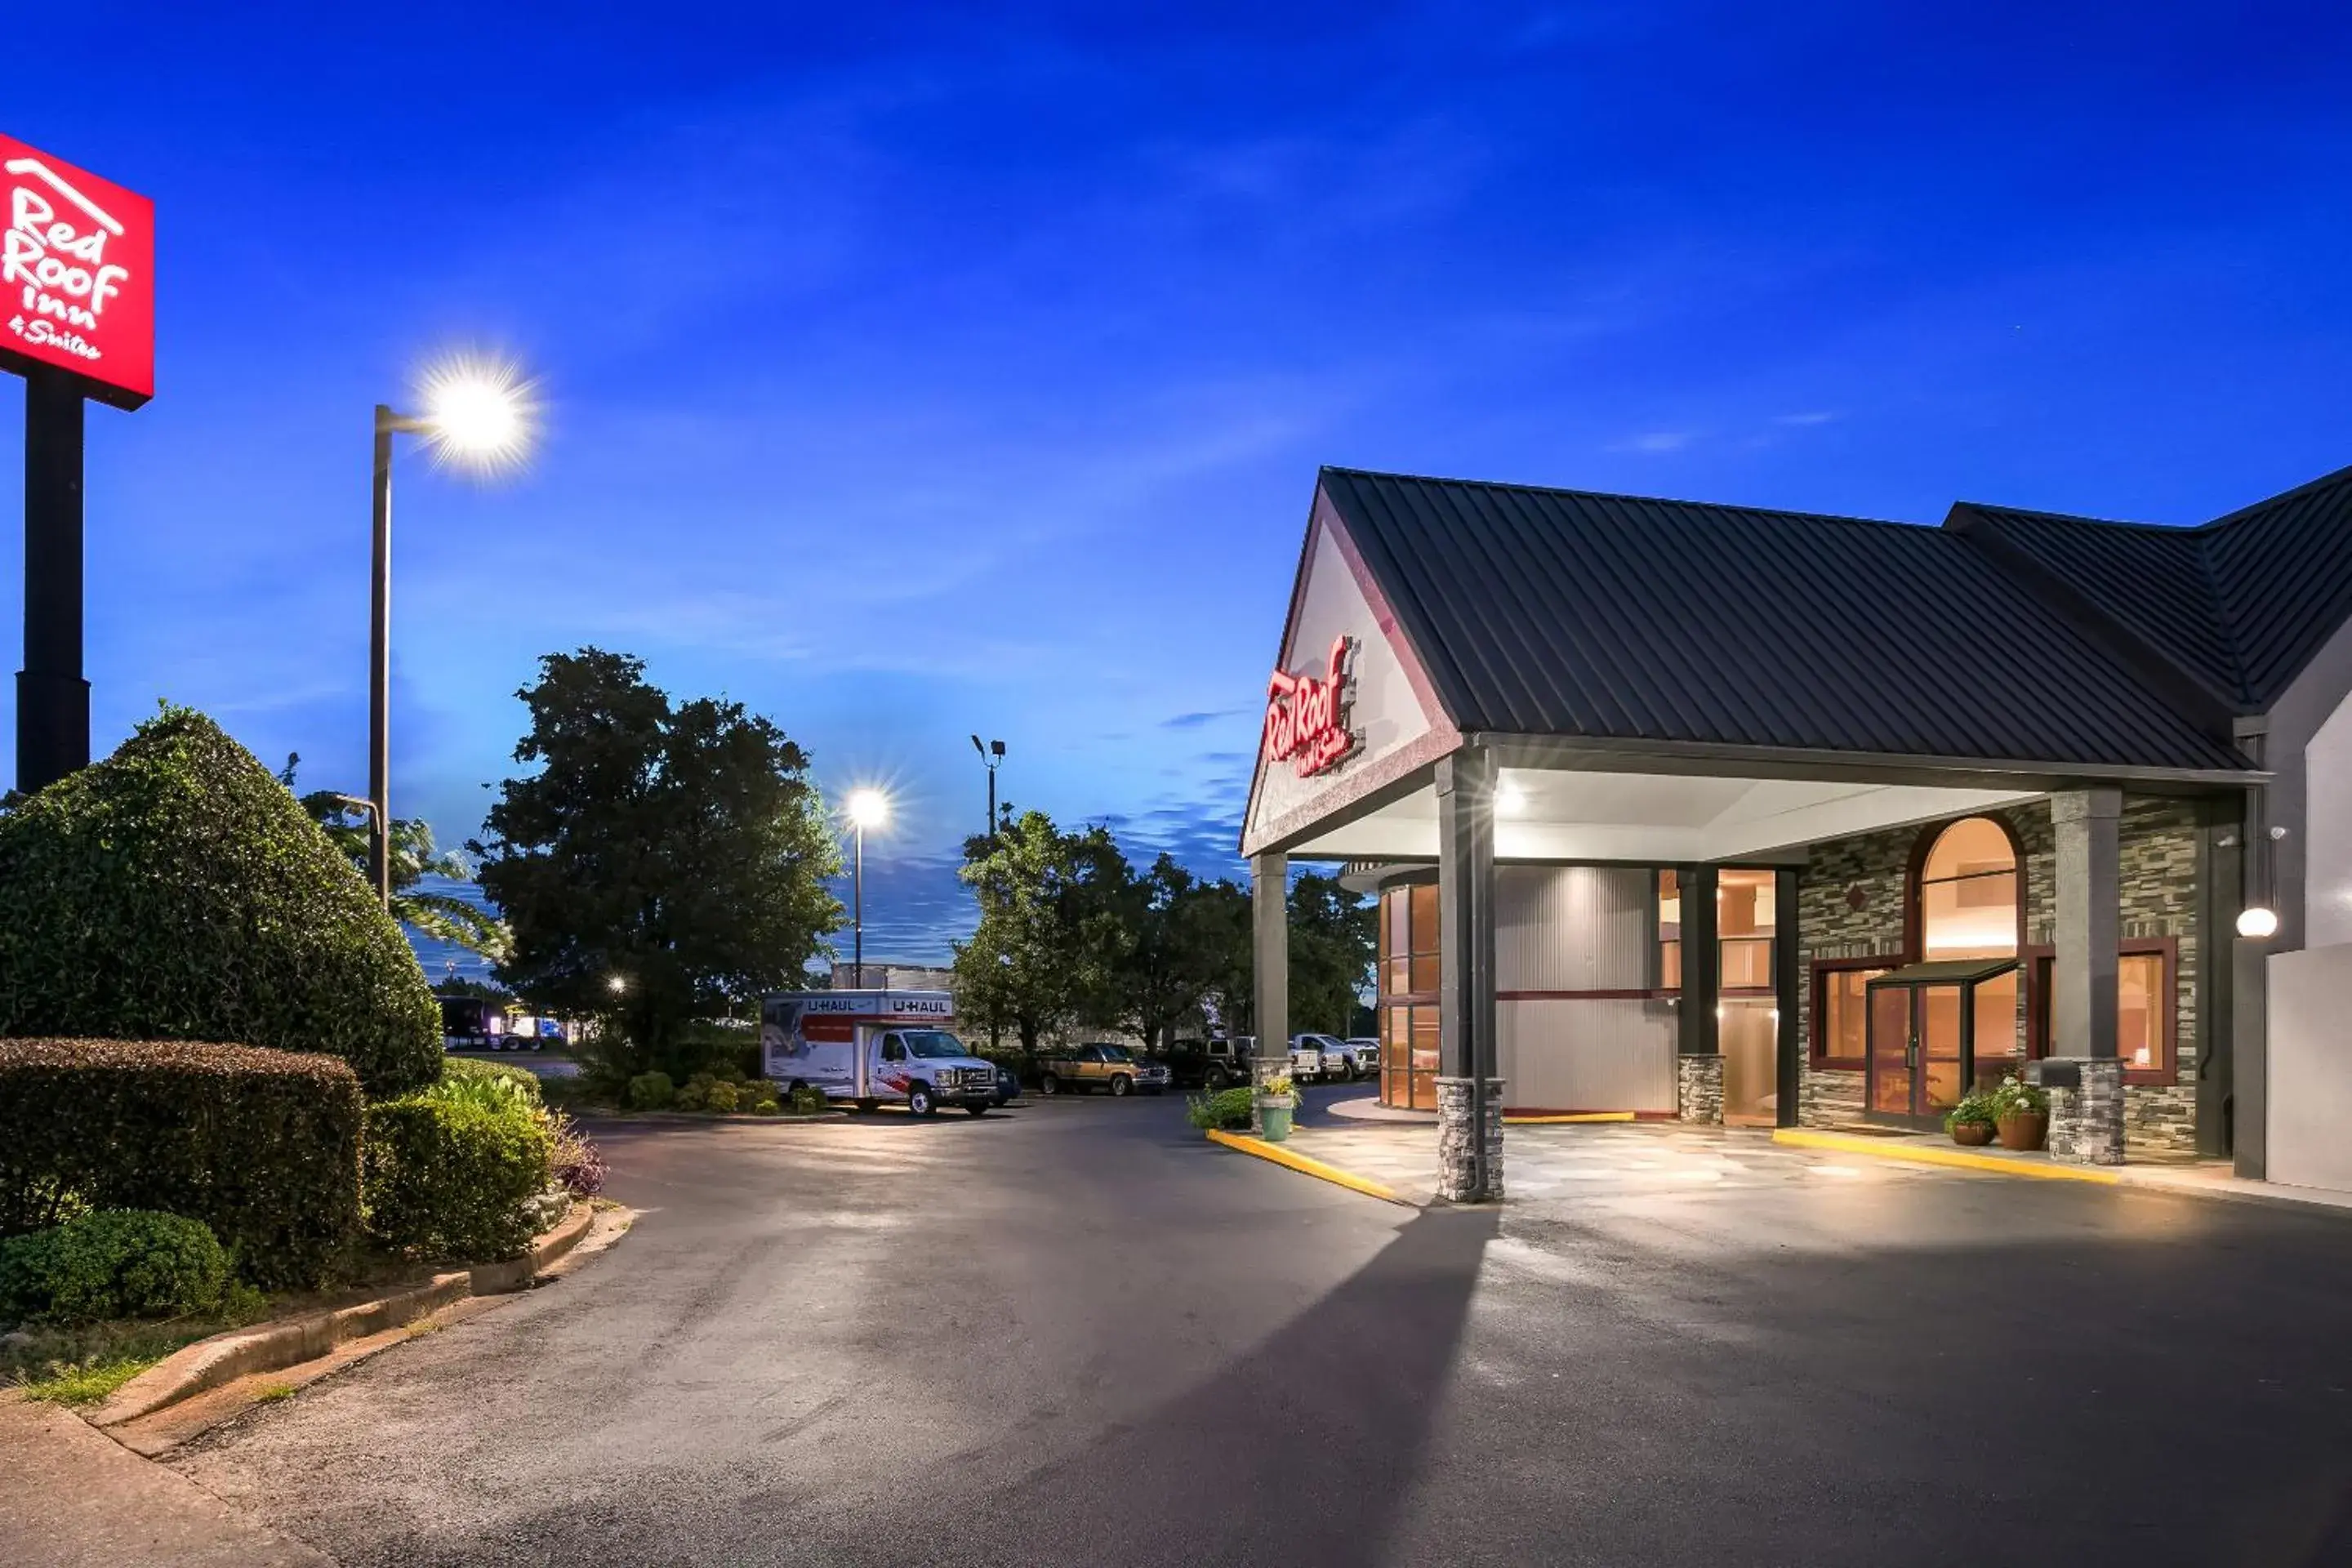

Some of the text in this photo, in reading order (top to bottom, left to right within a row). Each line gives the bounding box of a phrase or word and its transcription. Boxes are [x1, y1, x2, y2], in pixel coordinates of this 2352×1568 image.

[12, 187, 107, 265] Red
[2, 229, 128, 314] Roof
[1267, 633, 1345, 761] Red Roof
[808, 1000, 854, 1011] U-HAUL
[893, 1000, 947, 1013] U-HAUL
